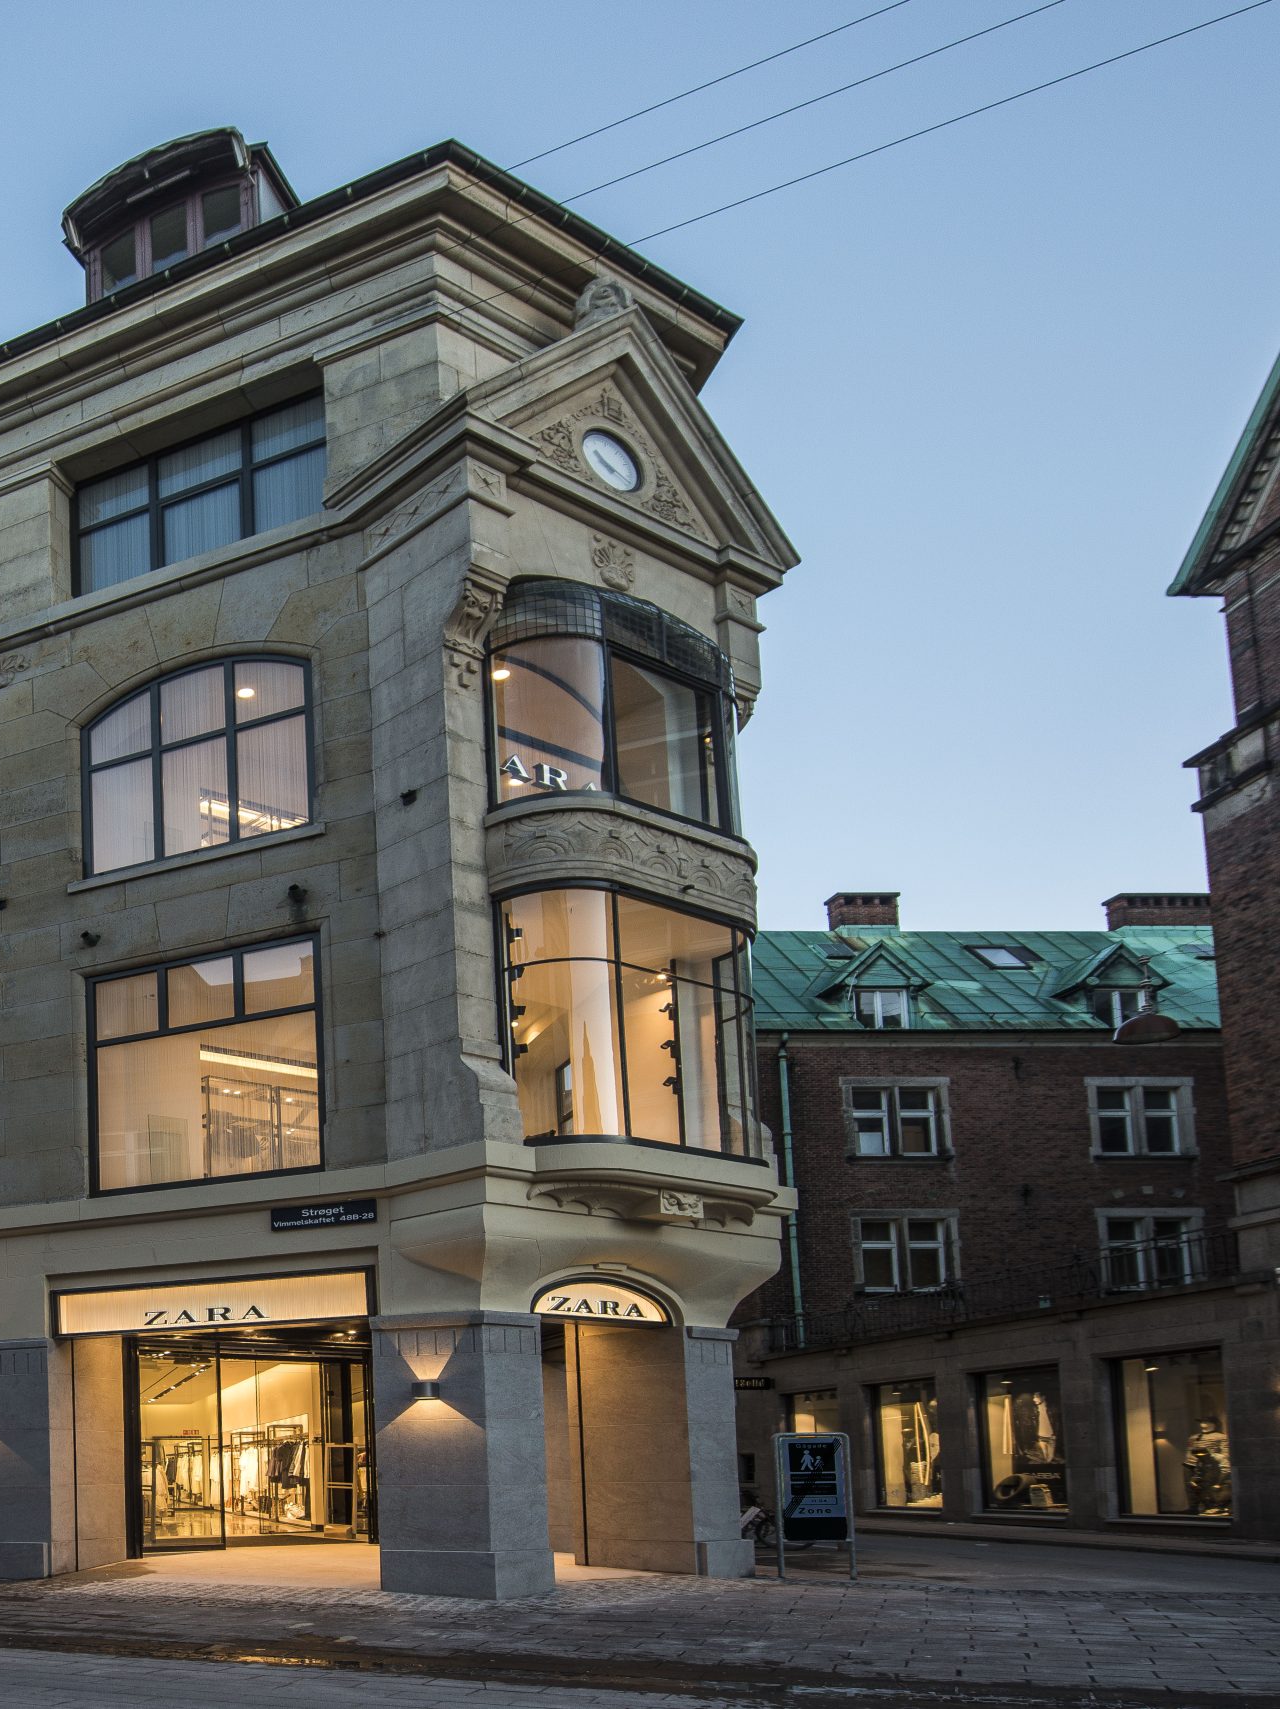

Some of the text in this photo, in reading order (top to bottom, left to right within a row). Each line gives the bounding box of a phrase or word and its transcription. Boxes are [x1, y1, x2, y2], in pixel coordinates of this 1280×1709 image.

[302, 1205, 345, 1217] Strøget
[273, 1216, 336, 1228] Vimmelskaftet
[547, 1296, 648, 1318] ZARA
[144, 1305, 270, 1326] ZARA
[798, 1506, 833, 1514] Zone
